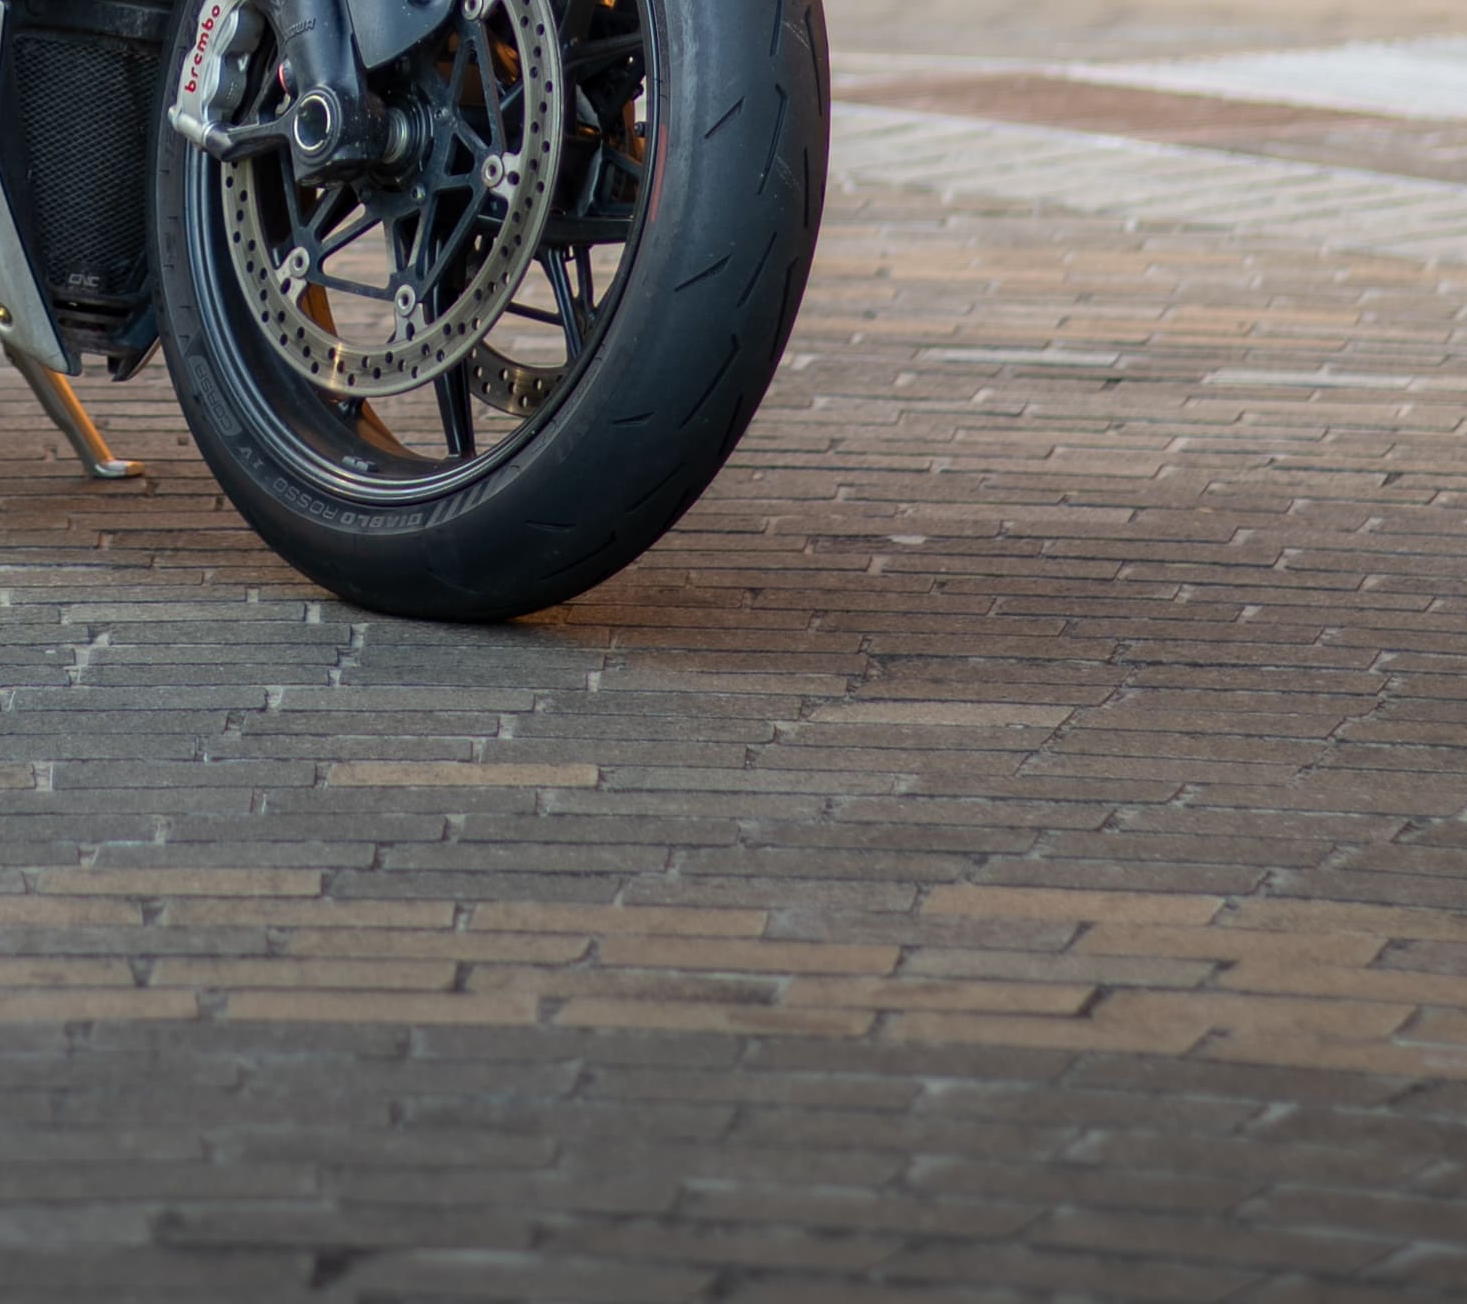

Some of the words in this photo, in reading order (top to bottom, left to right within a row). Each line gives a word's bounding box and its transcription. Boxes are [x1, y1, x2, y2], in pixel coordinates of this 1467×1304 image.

[185, 5, 220, 93] brembo
[273, 477, 340, 521] ROSSO
[340, 511, 426, 529] DIABLO
